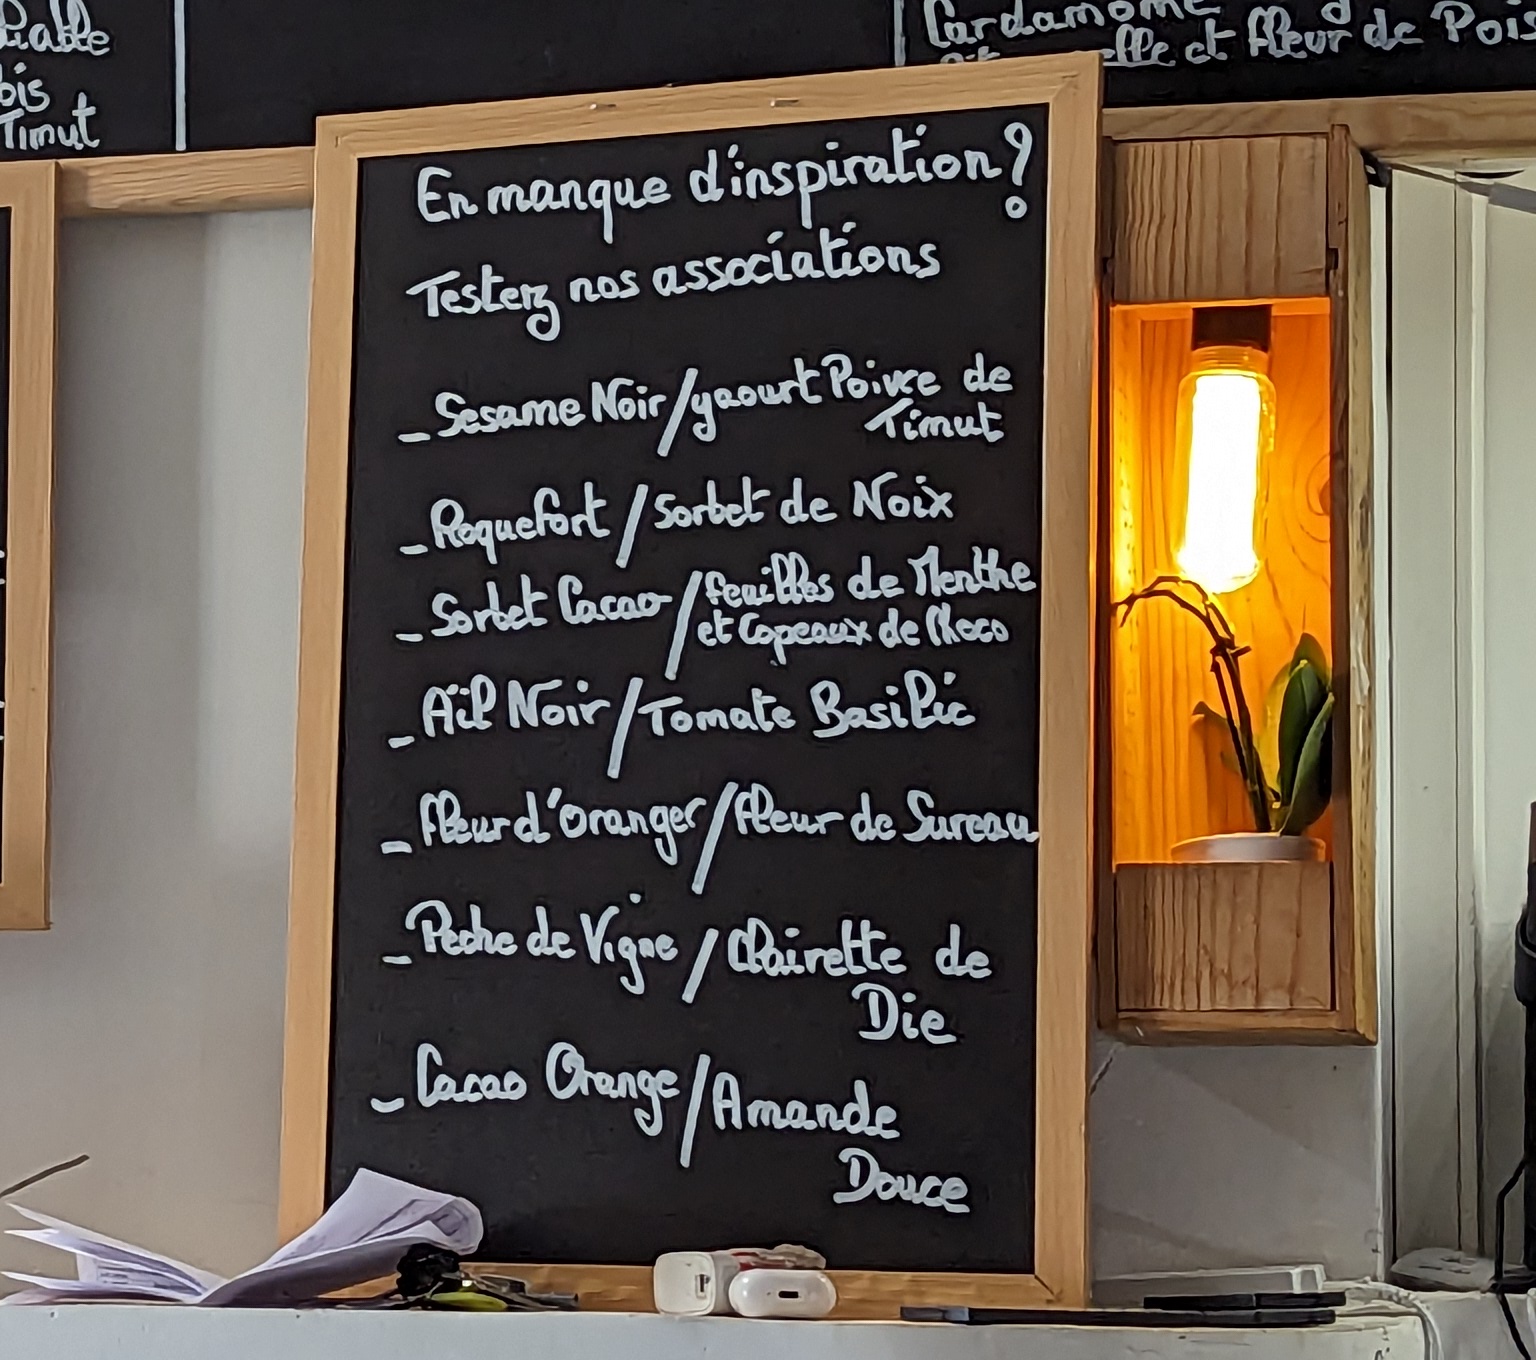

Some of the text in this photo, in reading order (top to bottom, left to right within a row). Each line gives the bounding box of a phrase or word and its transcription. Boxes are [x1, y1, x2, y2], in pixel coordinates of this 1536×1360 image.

[1184, 8, 1424, 64] et de
[417, 165, 672, 243] En manque
[406, 221, 941, 340] Testez nos associations
[962, 352, 1015, 391] de
[864, 396, 1004, 443] Timut
[779, 472, 954, 523] de Noix
[431, 545, 1036, 636] Sorbet de Menthe
[877, 609, 921, 647] de
[810, 670, 976, 738] Basilic
[850, 790, 1039, 843] de Sureau
[527, 906, 993, 978] de de
[852, 983, 957, 1044] Die
[417, 1042, 527, 1107] Cacao
[833, 1147, 971, 1213] Douce
